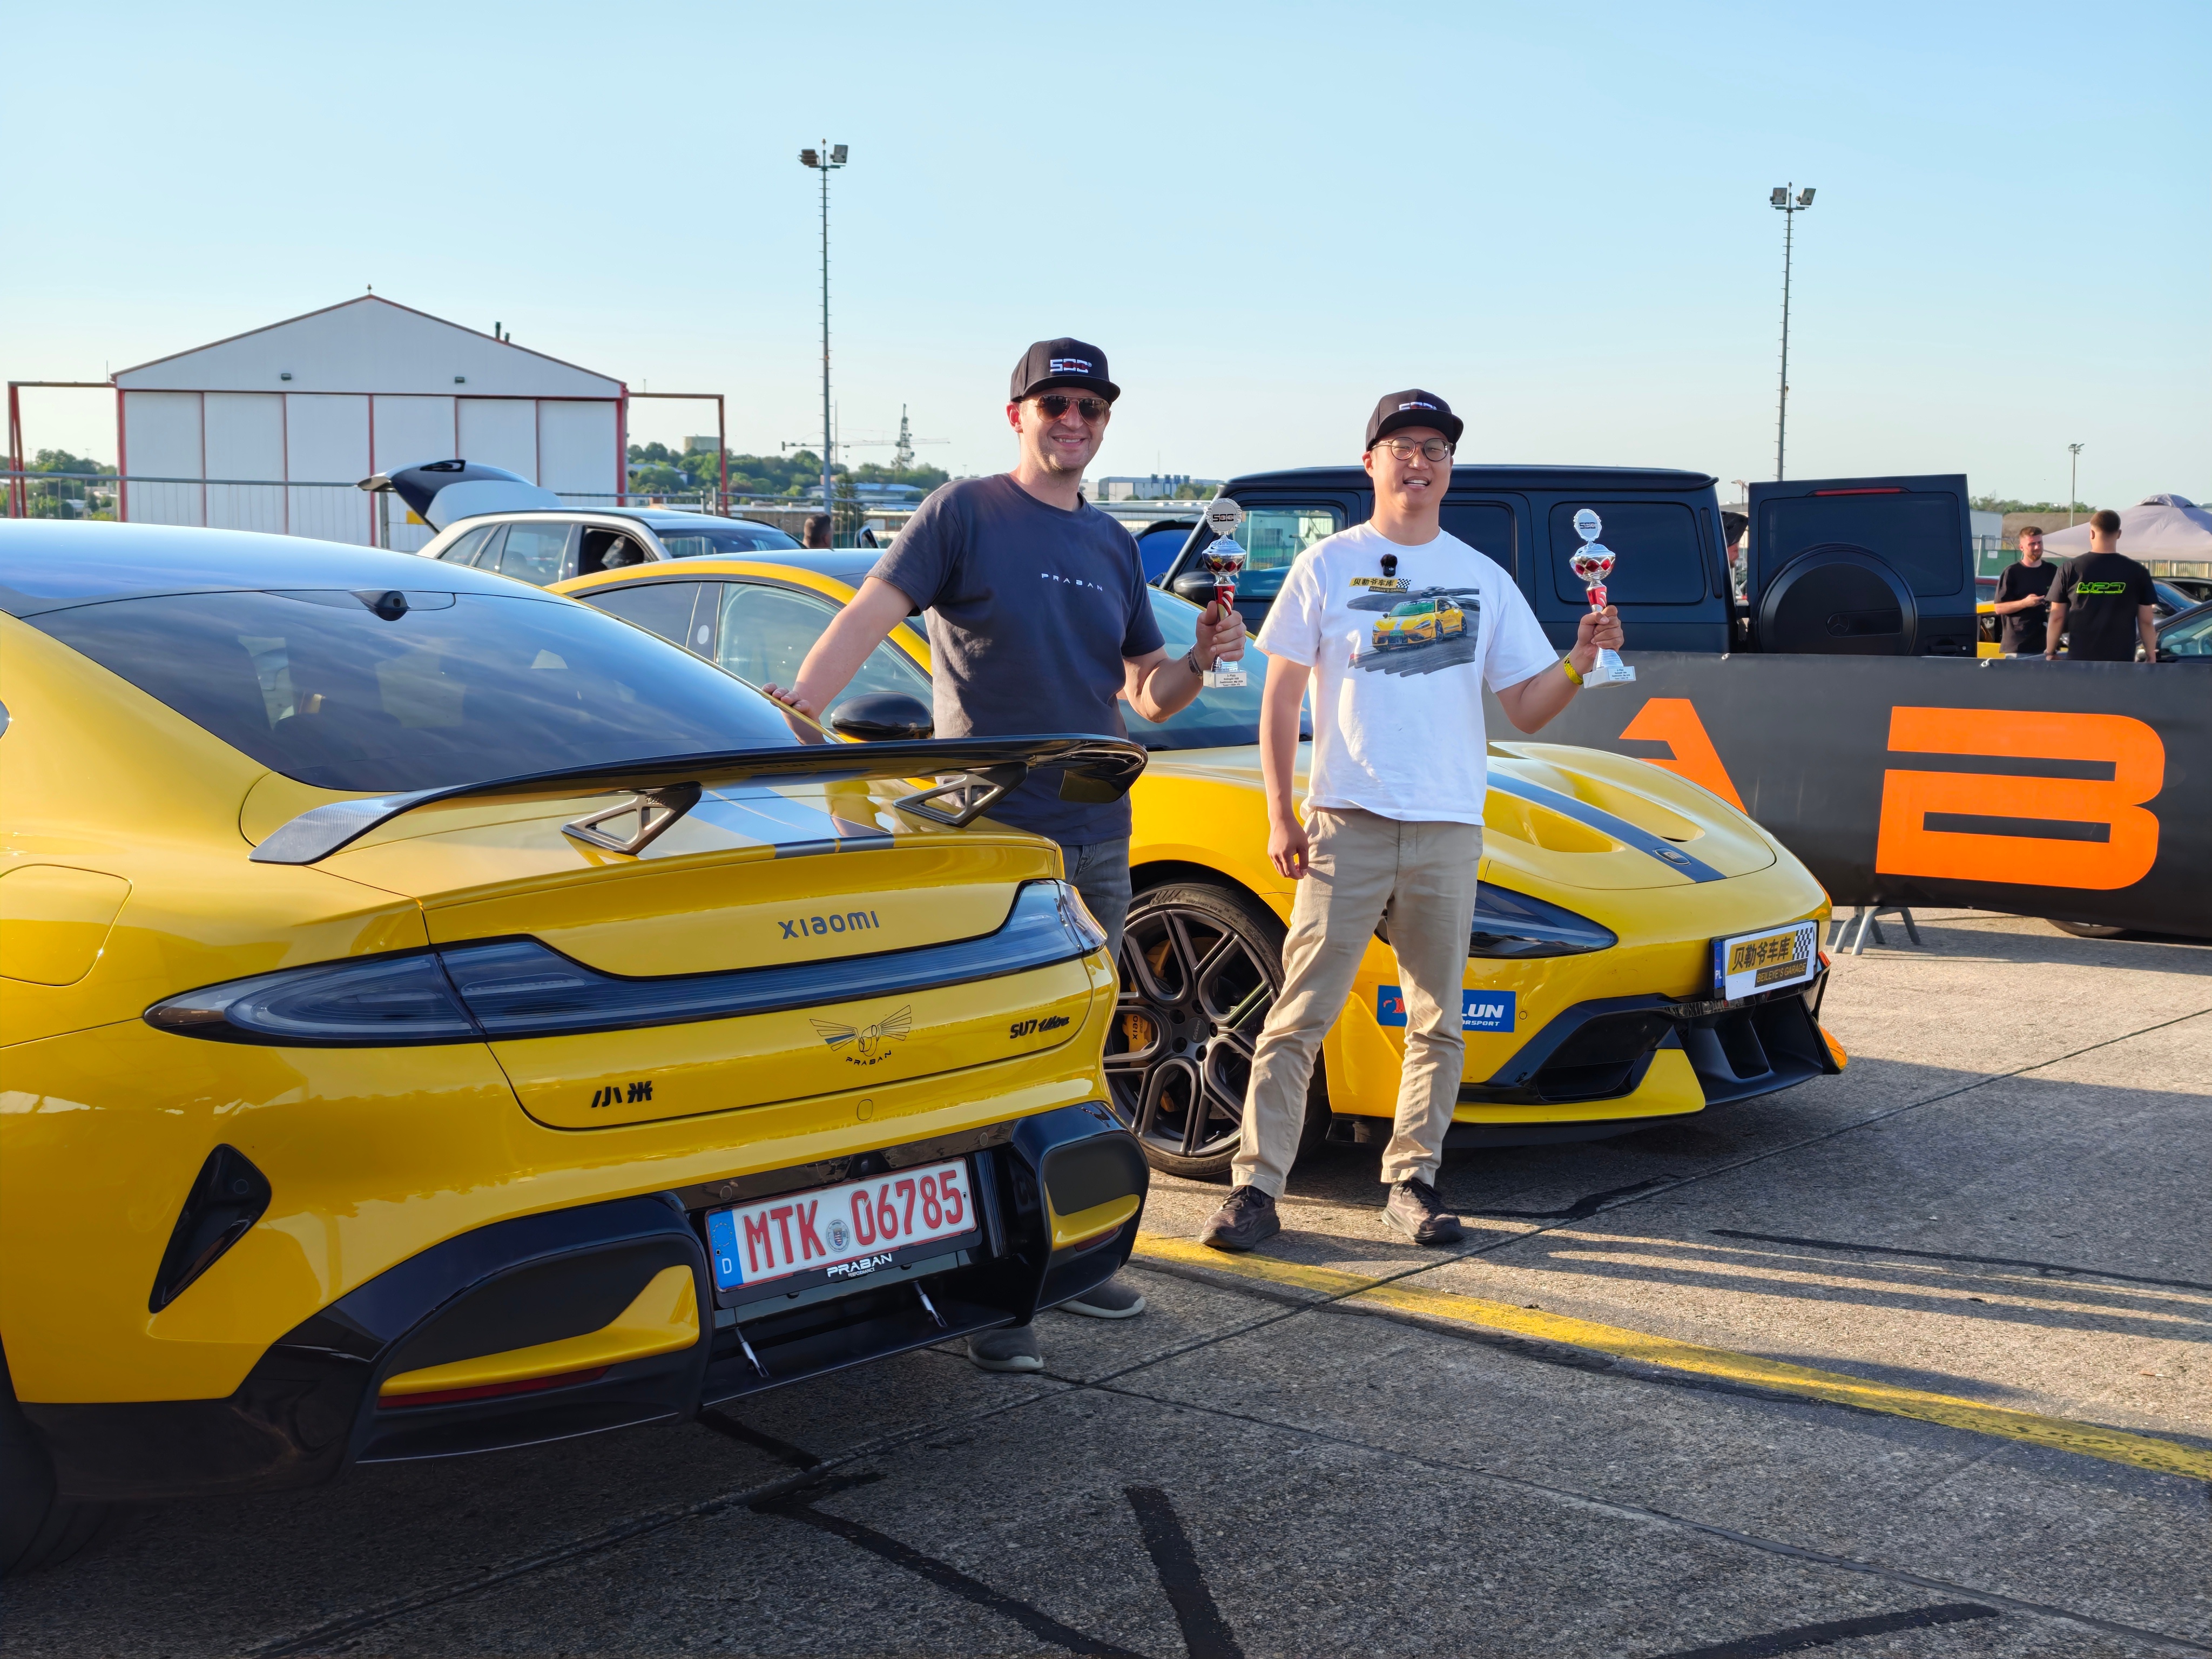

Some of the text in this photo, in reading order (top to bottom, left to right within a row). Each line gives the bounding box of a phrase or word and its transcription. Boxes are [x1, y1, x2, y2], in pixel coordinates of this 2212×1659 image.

[1041, 573, 1103, 592] PRABAN
[1732, 936, 1791, 972] 贝勒爷车库
[1715, 970, 1722, 980] PL
[1757, 962, 1807, 983] BEILEYE'S GARAGE
[1009, 1019, 1037, 1039] SU7
[846, 1050, 891, 1066] PRABAN
[591, 1081, 653, 1108] 小米
[744, 1169, 963, 1273] MTK 06785
[722, 1258, 732, 1274] D
[827, 1253, 892, 1278] PRABAN
[847, 1267, 875, 1277] PERFORMANCE
